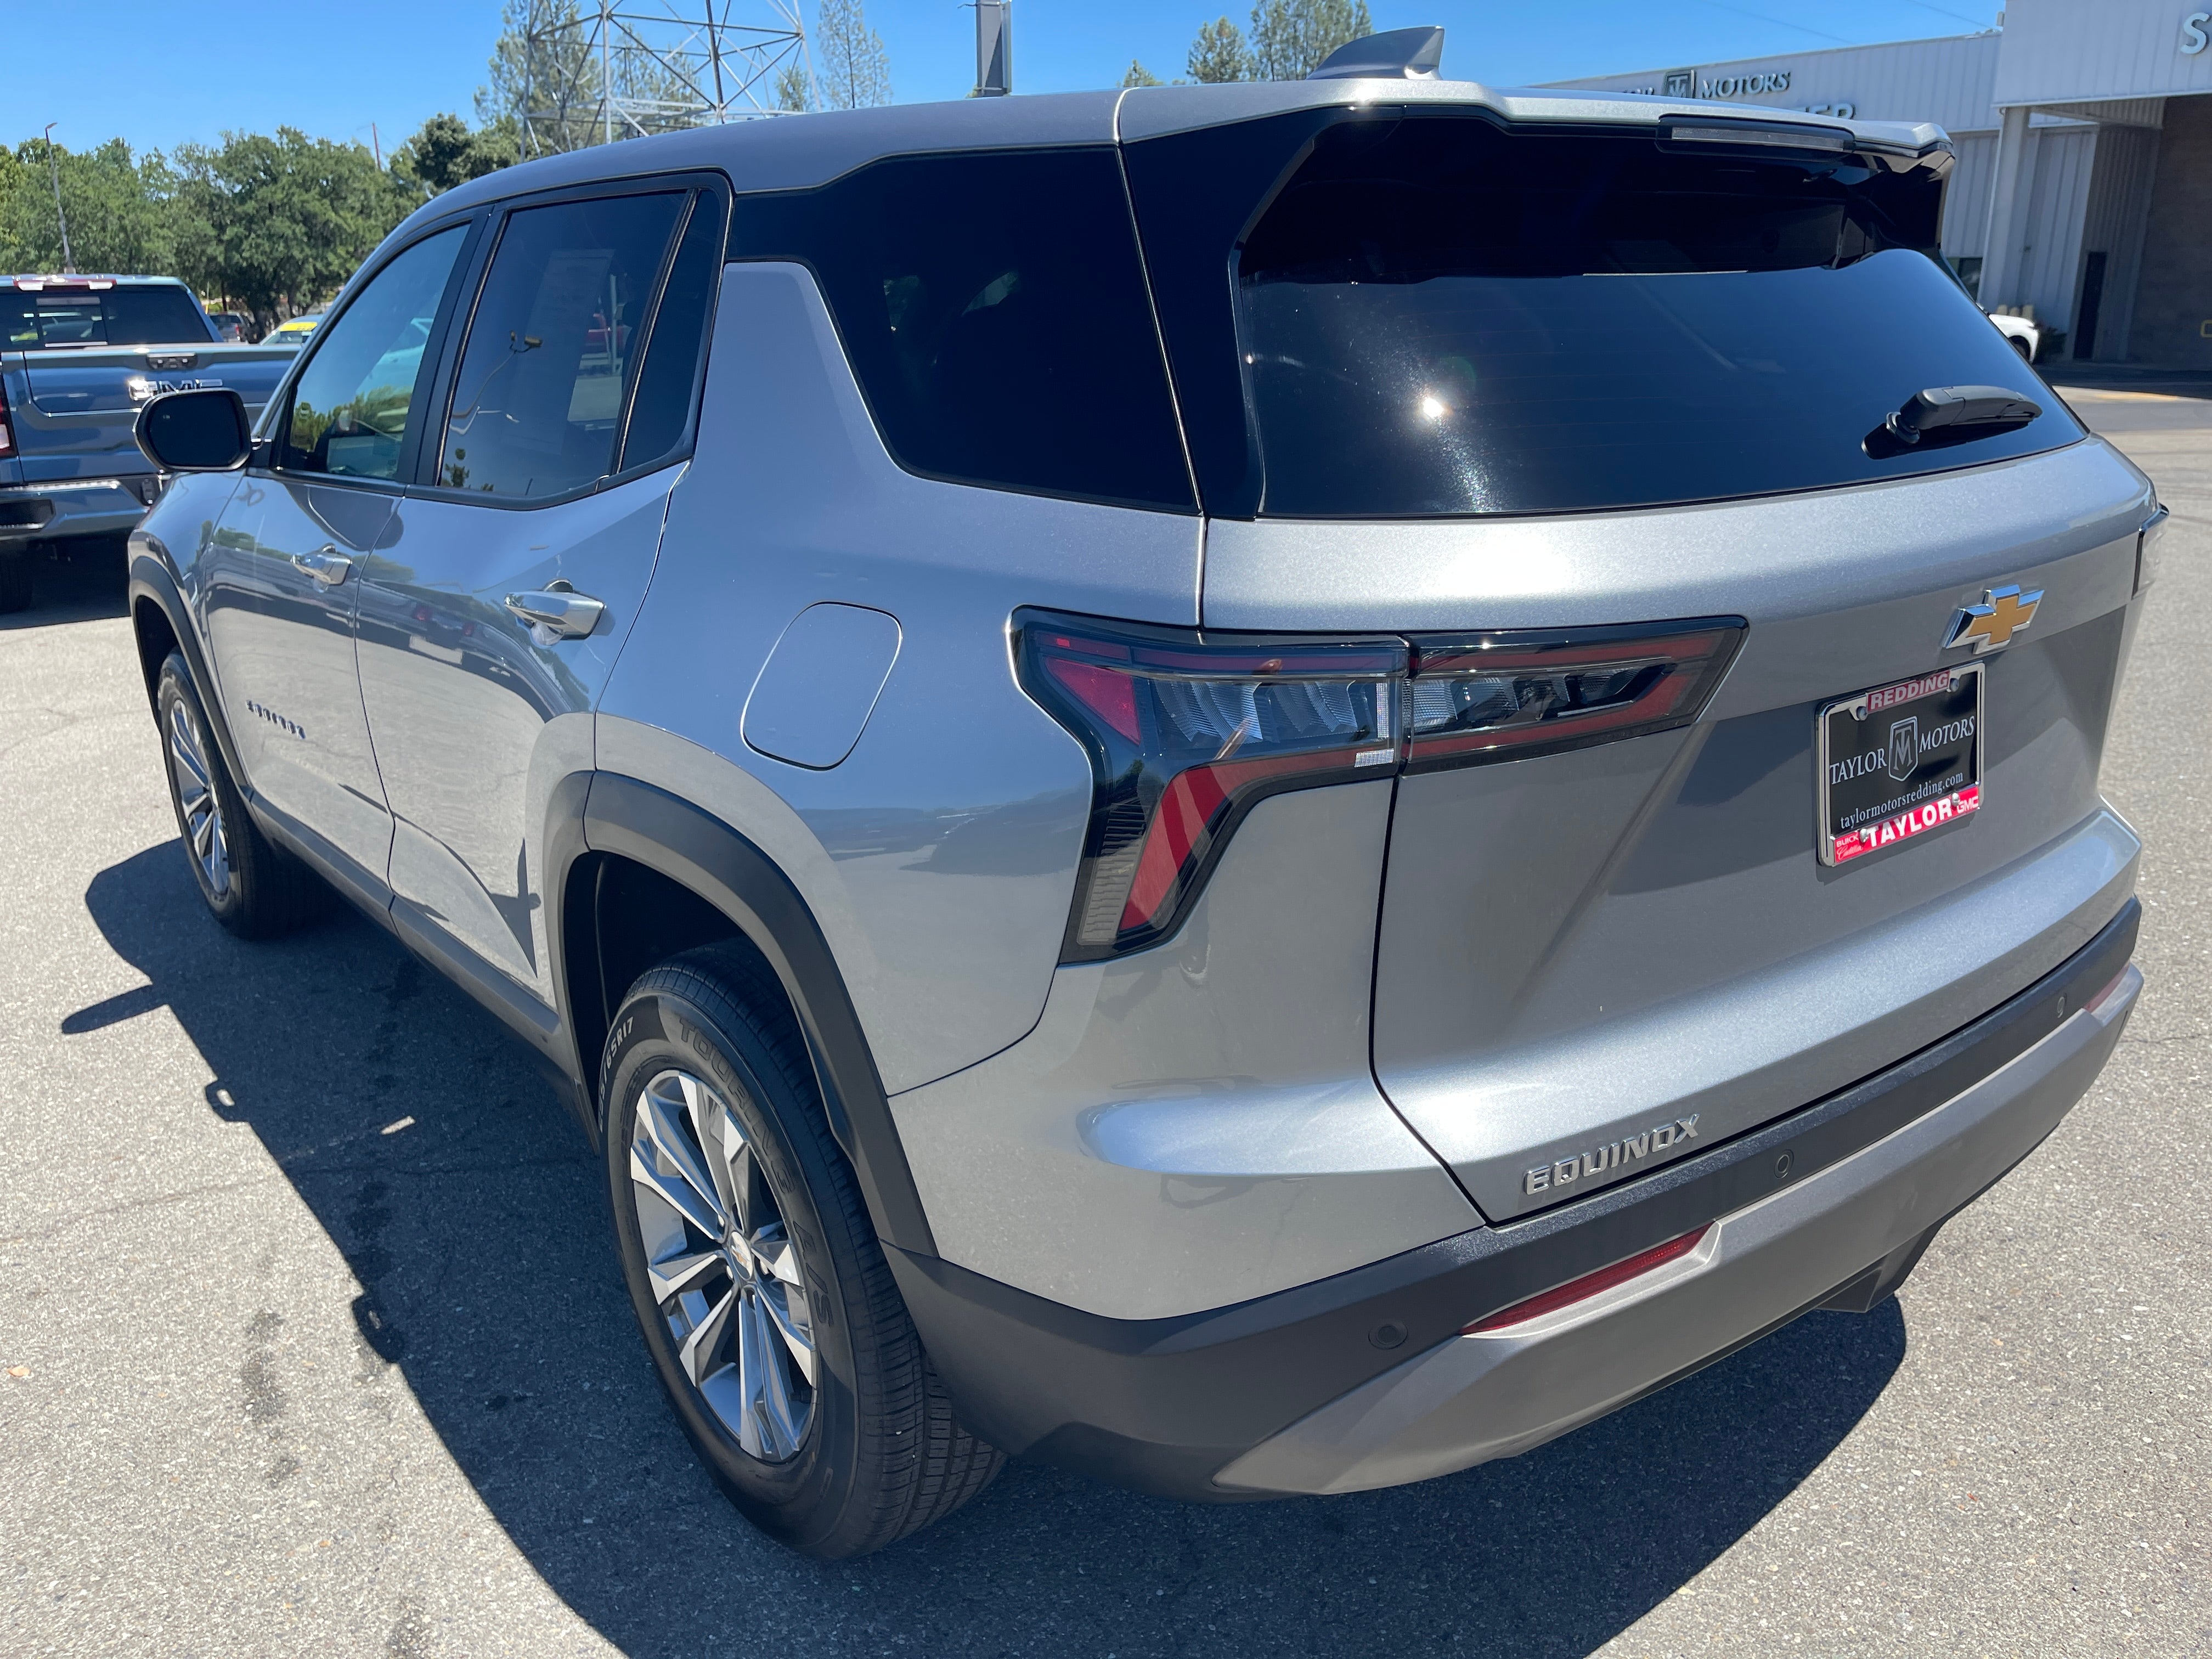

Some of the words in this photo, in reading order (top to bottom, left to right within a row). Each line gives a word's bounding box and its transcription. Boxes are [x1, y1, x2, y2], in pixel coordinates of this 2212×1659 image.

[1702, 71, 1790, 99] MOTORS
[1870, 675, 1949, 709] REDDING
[1830, 747, 1887, 785] TAYLOR
[1919, 716, 1975, 753] MOTORS
[1841, 771, 1963, 829] taylormotorsredding.com
[1956, 795, 1979, 814] GMC
[1837, 834, 1859, 847] BUICK
[1866, 798, 1953, 847] TAYLOR
[1525, 1114, 1700, 1195] EQUINOX
